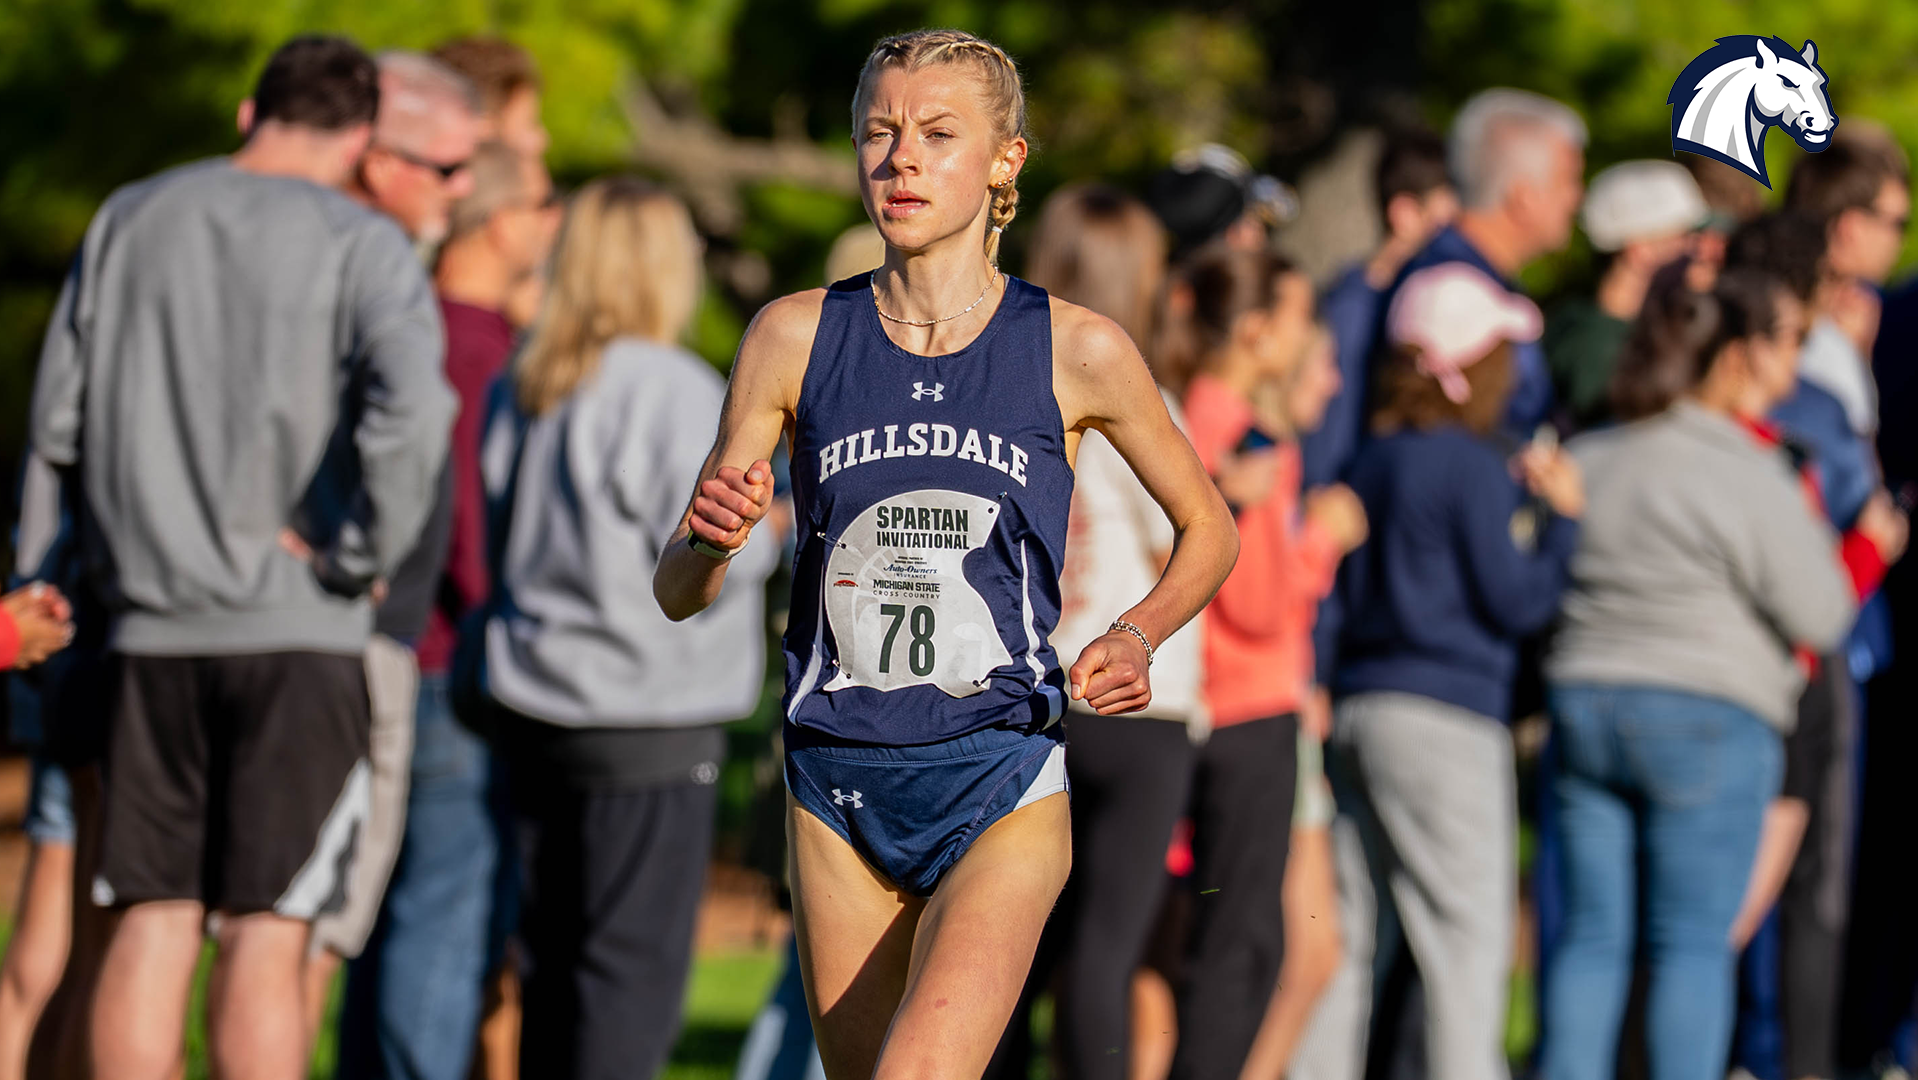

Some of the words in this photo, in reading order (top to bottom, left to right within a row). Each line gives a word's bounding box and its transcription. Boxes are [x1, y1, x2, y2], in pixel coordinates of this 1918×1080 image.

[819, 423, 1029, 488] HILLSDALE
[877, 506, 969, 532] SPARTAN
[877, 531, 970, 550] INVITATIONAL
[883, 563, 938, 574] Auto-Owners
[873, 579, 914, 591] MICHIGAN
[915, 582, 941, 592] STATE
[879, 603, 936, 677] 78
